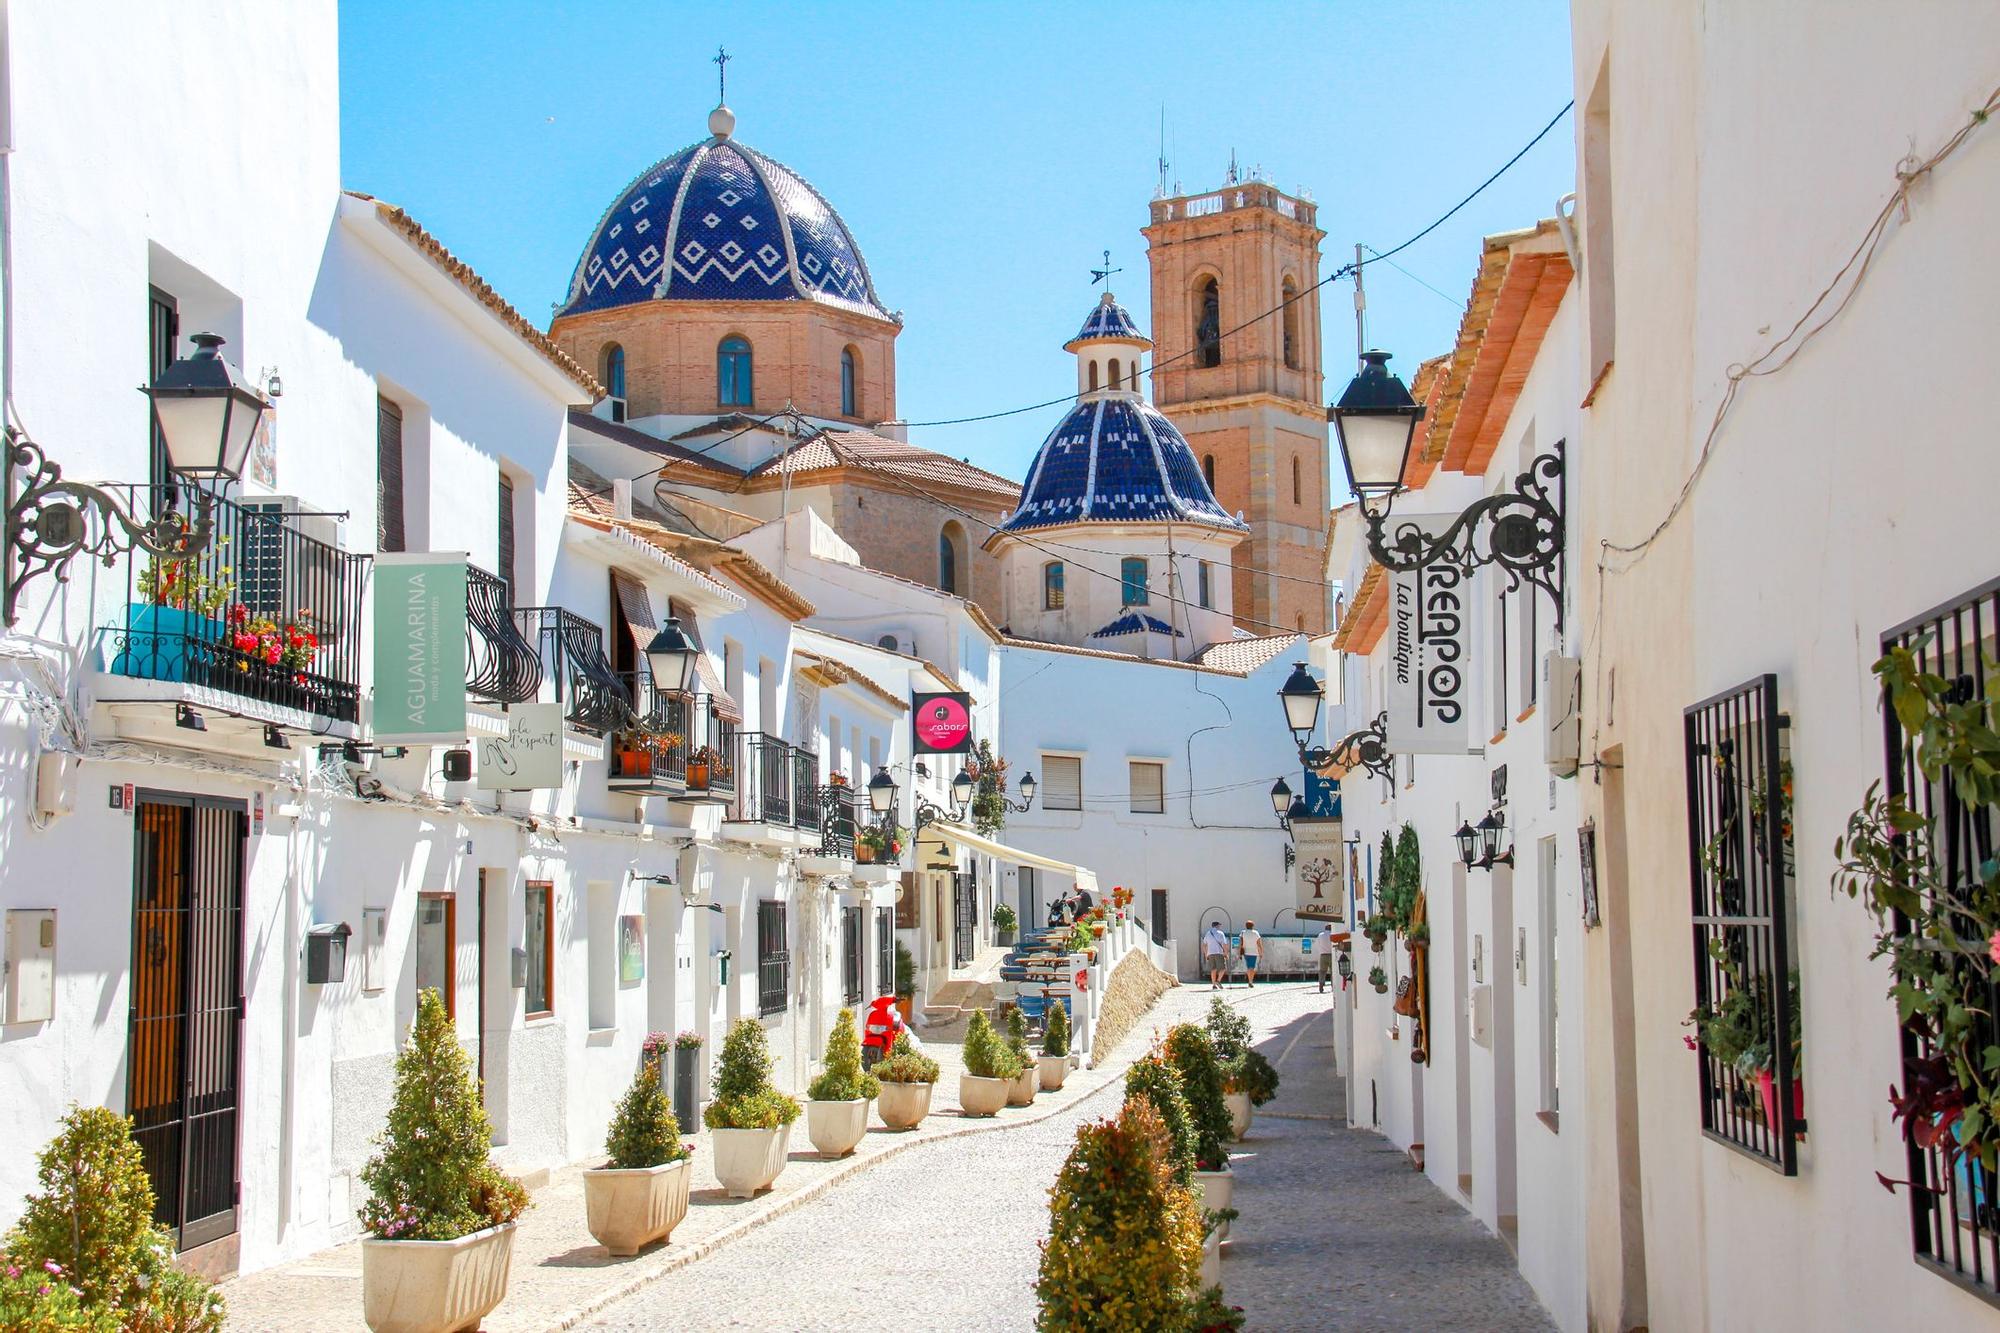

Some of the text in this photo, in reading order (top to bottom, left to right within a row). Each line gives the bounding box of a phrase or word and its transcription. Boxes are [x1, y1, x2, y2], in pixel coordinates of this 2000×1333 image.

[407, 572, 427, 725] AGUAMARINA
[1393, 582, 1413, 685] La boutique
[430, 674, 440, 702] moda
